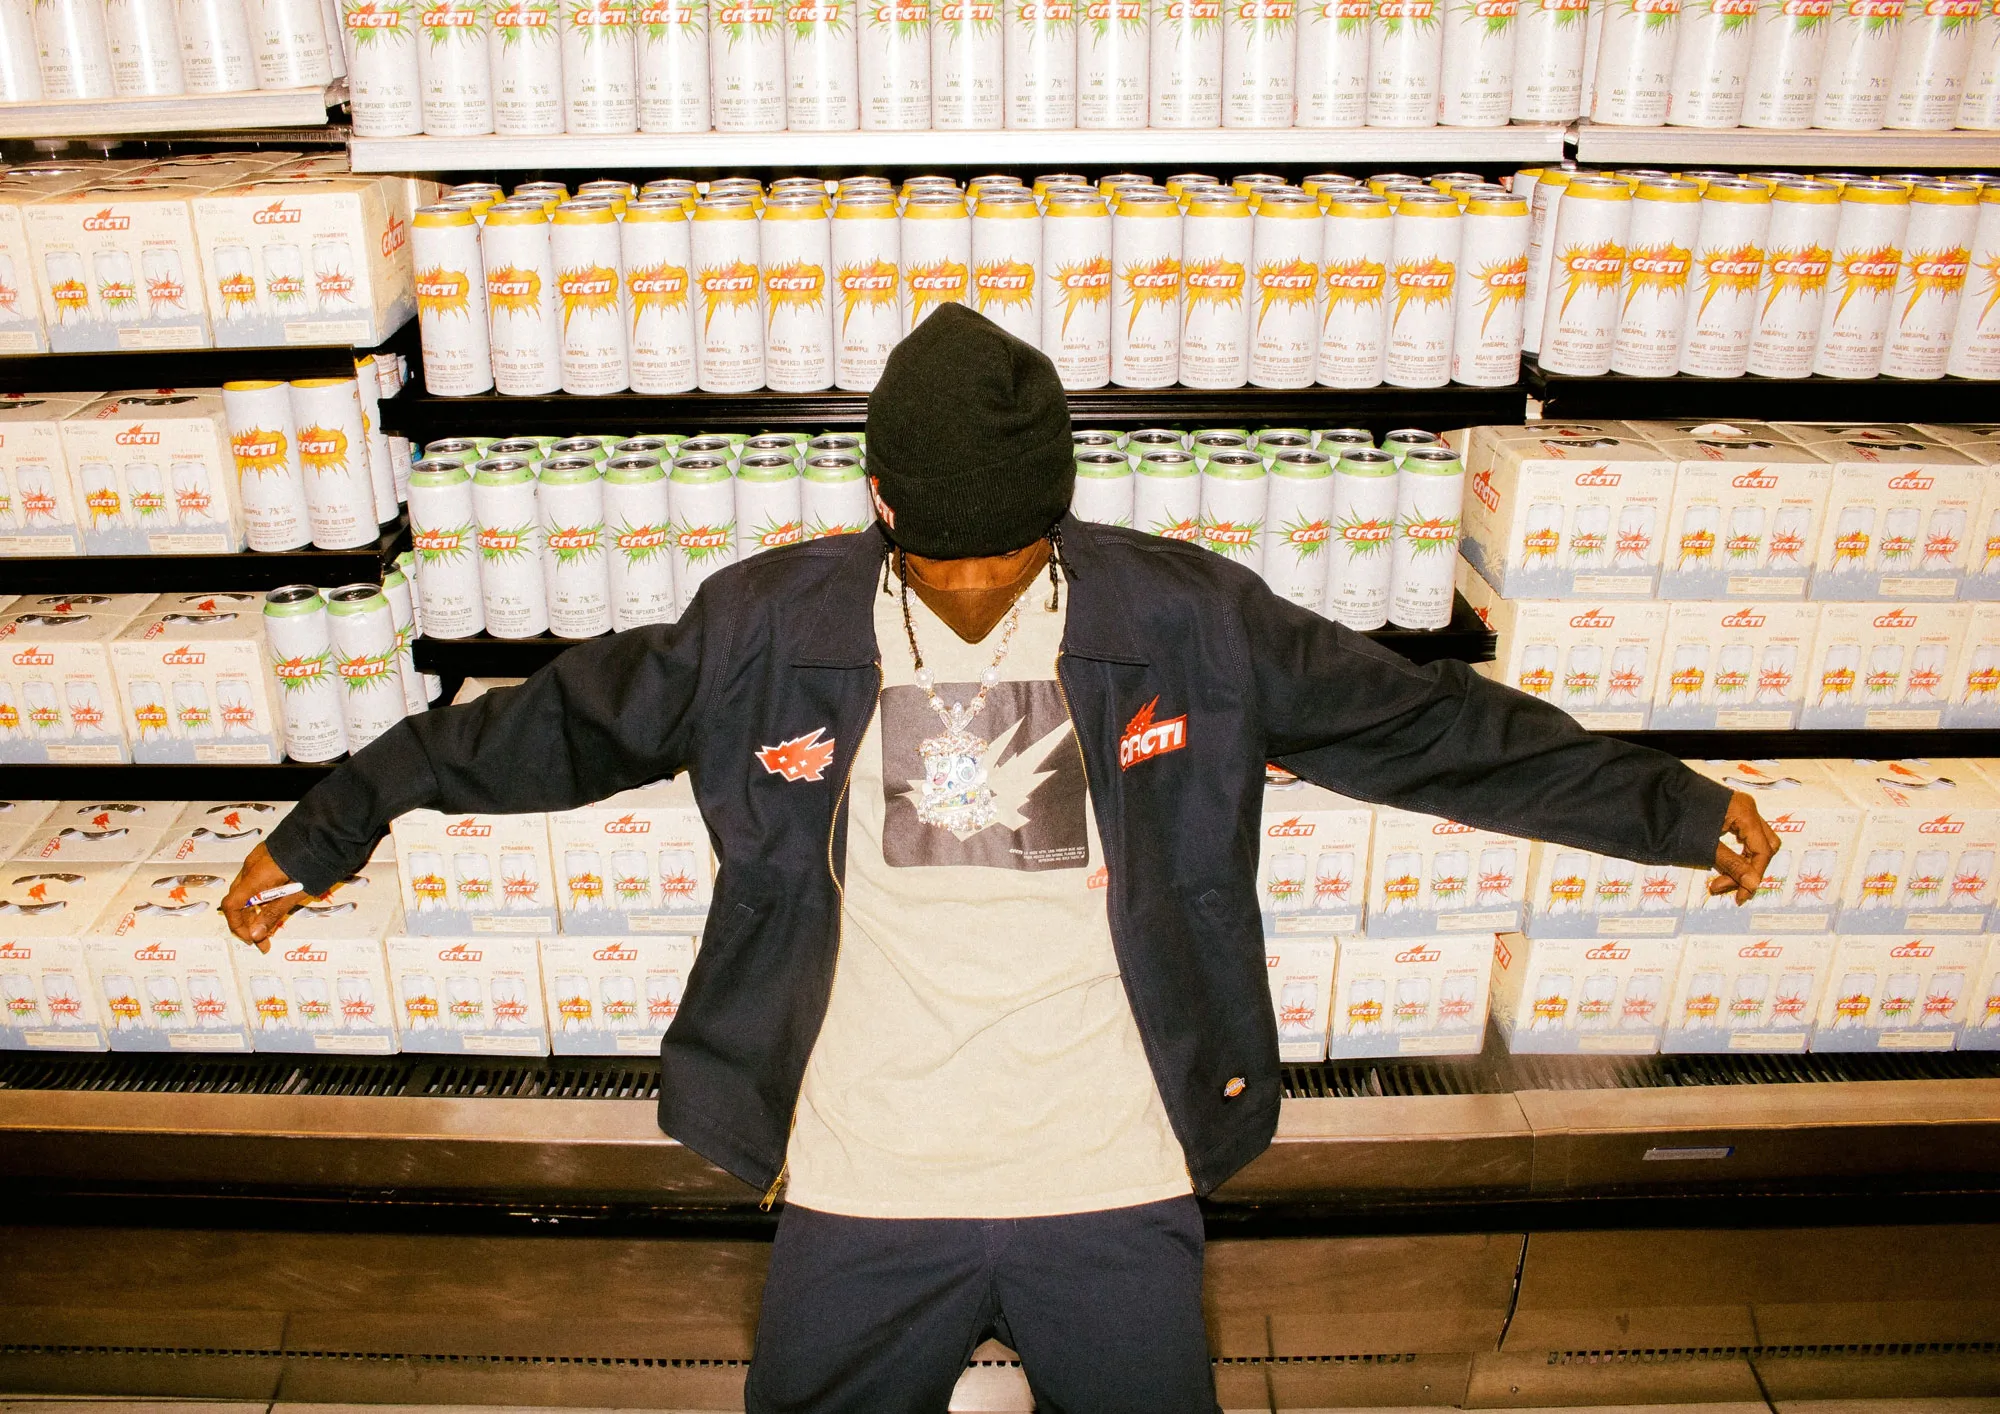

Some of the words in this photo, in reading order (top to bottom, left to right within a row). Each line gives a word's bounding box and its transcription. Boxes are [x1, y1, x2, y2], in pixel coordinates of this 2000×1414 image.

[789, 7, 837, 21] CACTI
[878, 7, 926, 21] CACTI
[943, 5, 993, 20] CACTI
[1023, 5, 1072, 19] CACTI
[1088, 4, 1139, 18] CACTI
[1169, 4, 1218, 18] CACTI
[1244, 3, 1292, 17] CACTI
[1381, 2, 1431, 16] CACTI
[1850, 1, 1904, 15] CACTI
[349, 11, 398, 26] CACTI
[423, 11, 475, 26] CACTI
[497, 12, 547, 26] CACTI
[577, 9, 626, 25] CACTI
[642, 9, 690, 24] CACTI
[722, 8, 772, 22] CACTI
[84, 217, 129, 230] CACTI
[254, 210, 301, 224] CACTI
[1571, 258, 1621, 272] CACTI
[1633, 259, 1684, 273] CACTI
[1710, 262, 1762, 275] CACTI
[1774, 262, 1826, 276] CACTI
[1848, 263, 1897, 276] CACTI
[1916, 263, 1967, 275] CACTI
[633, 278, 680, 292] CACTI
[706, 277, 753, 290] CACTI
[769, 277, 816, 290] CACTI
[846, 276, 892, 288] CACTI
[913, 276, 961, 288] CACTI
[979, 275, 1026, 288] CACTI
[1067, 274, 1110, 287] CACTI
[1134, 274, 1178, 287] CACTI
[1188, 274, 1237, 286] CACTI
[1263, 274, 1312, 287] CACTI
[1329, 274, 1378, 287] CACTI
[1401, 274, 1450, 287] CACTI
[1491, 273, 1527, 285] CACT
[223, 284, 253, 294] CACTI
[271, 283, 300, 292] CACTI
[319, 282, 350, 291] CACTI
[417, 283, 458, 296] CACTI
[490, 281, 530, 294] CACTI
[563, 280, 610, 293] CACTI
[56, 290, 85, 300] CACTI
[103, 290, 131, 299] CACTI
[117, 433, 160, 444] CACTI
[233, 442, 277, 456] CACTI
[1576, 474, 1621, 486] CACTI
[1734, 476, 1778, 488] CACTI
[1889, 477, 1933, 489] CACTI
[1474, 475, 1499, 510] CACTI
[90, 499, 116, 507] CACTI
[1204, 528, 1250, 542] CACTI
[1345, 526, 1391, 539] CACTI
[1408, 526, 1454, 538] CACTI
[415, 536, 458, 548] CACTI
[478, 535, 517, 548] CACTI
[549, 533, 596, 547] CACTI
[620, 533, 665, 546] CACTI
[681, 533, 726, 546] CACTI
[1527, 539, 1558, 547] CACTI
[1684, 540, 1714, 548] CACTI
[1837, 541, 1869, 549] CACTI
[1571, 617, 1614, 627] CACTI
[1723, 616, 1765, 627] CACTI
[1874, 616, 1916, 627] CACTI
[13, 655, 54, 665] CACTI
[164, 653, 205, 664] CACTI
[276, 662, 322, 676] CACTI
[338, 662, 384, 676] CACTI
[1120, 720, 1184, 767] CACTI
[447, 826, 491, 837] CACTI
[606, 822, 649, 833] CACTI
[1269, 824, 1315, 836] CACTI
[1770, 821, 1804, 832] ACTI
[1920, 822, 1964, 833] CACTI
[461, 884, 487, 892] CACTI
[572, 882, 599, 890] CACTI
[617, 882, 645, 890] CACTI
[1435, 882, 1463, 890] CACTI
[1552, 884, 1582, 892] CACTI
[0, 949, 30, 958] ACTI
[136, 950, 175, 960] CACTI
[286, 951, 327, 961] CACTI
[440, 952, 482, 961] CACTI
[594, 951, 637, 961] CACTI
[1396, 951, 1440, 962] CACTI
[1586, 949, 1630, 959] CACTI
[1739, 947, 1782, 957] CACTI
[1891, 947, 1934, 957] CACTI
